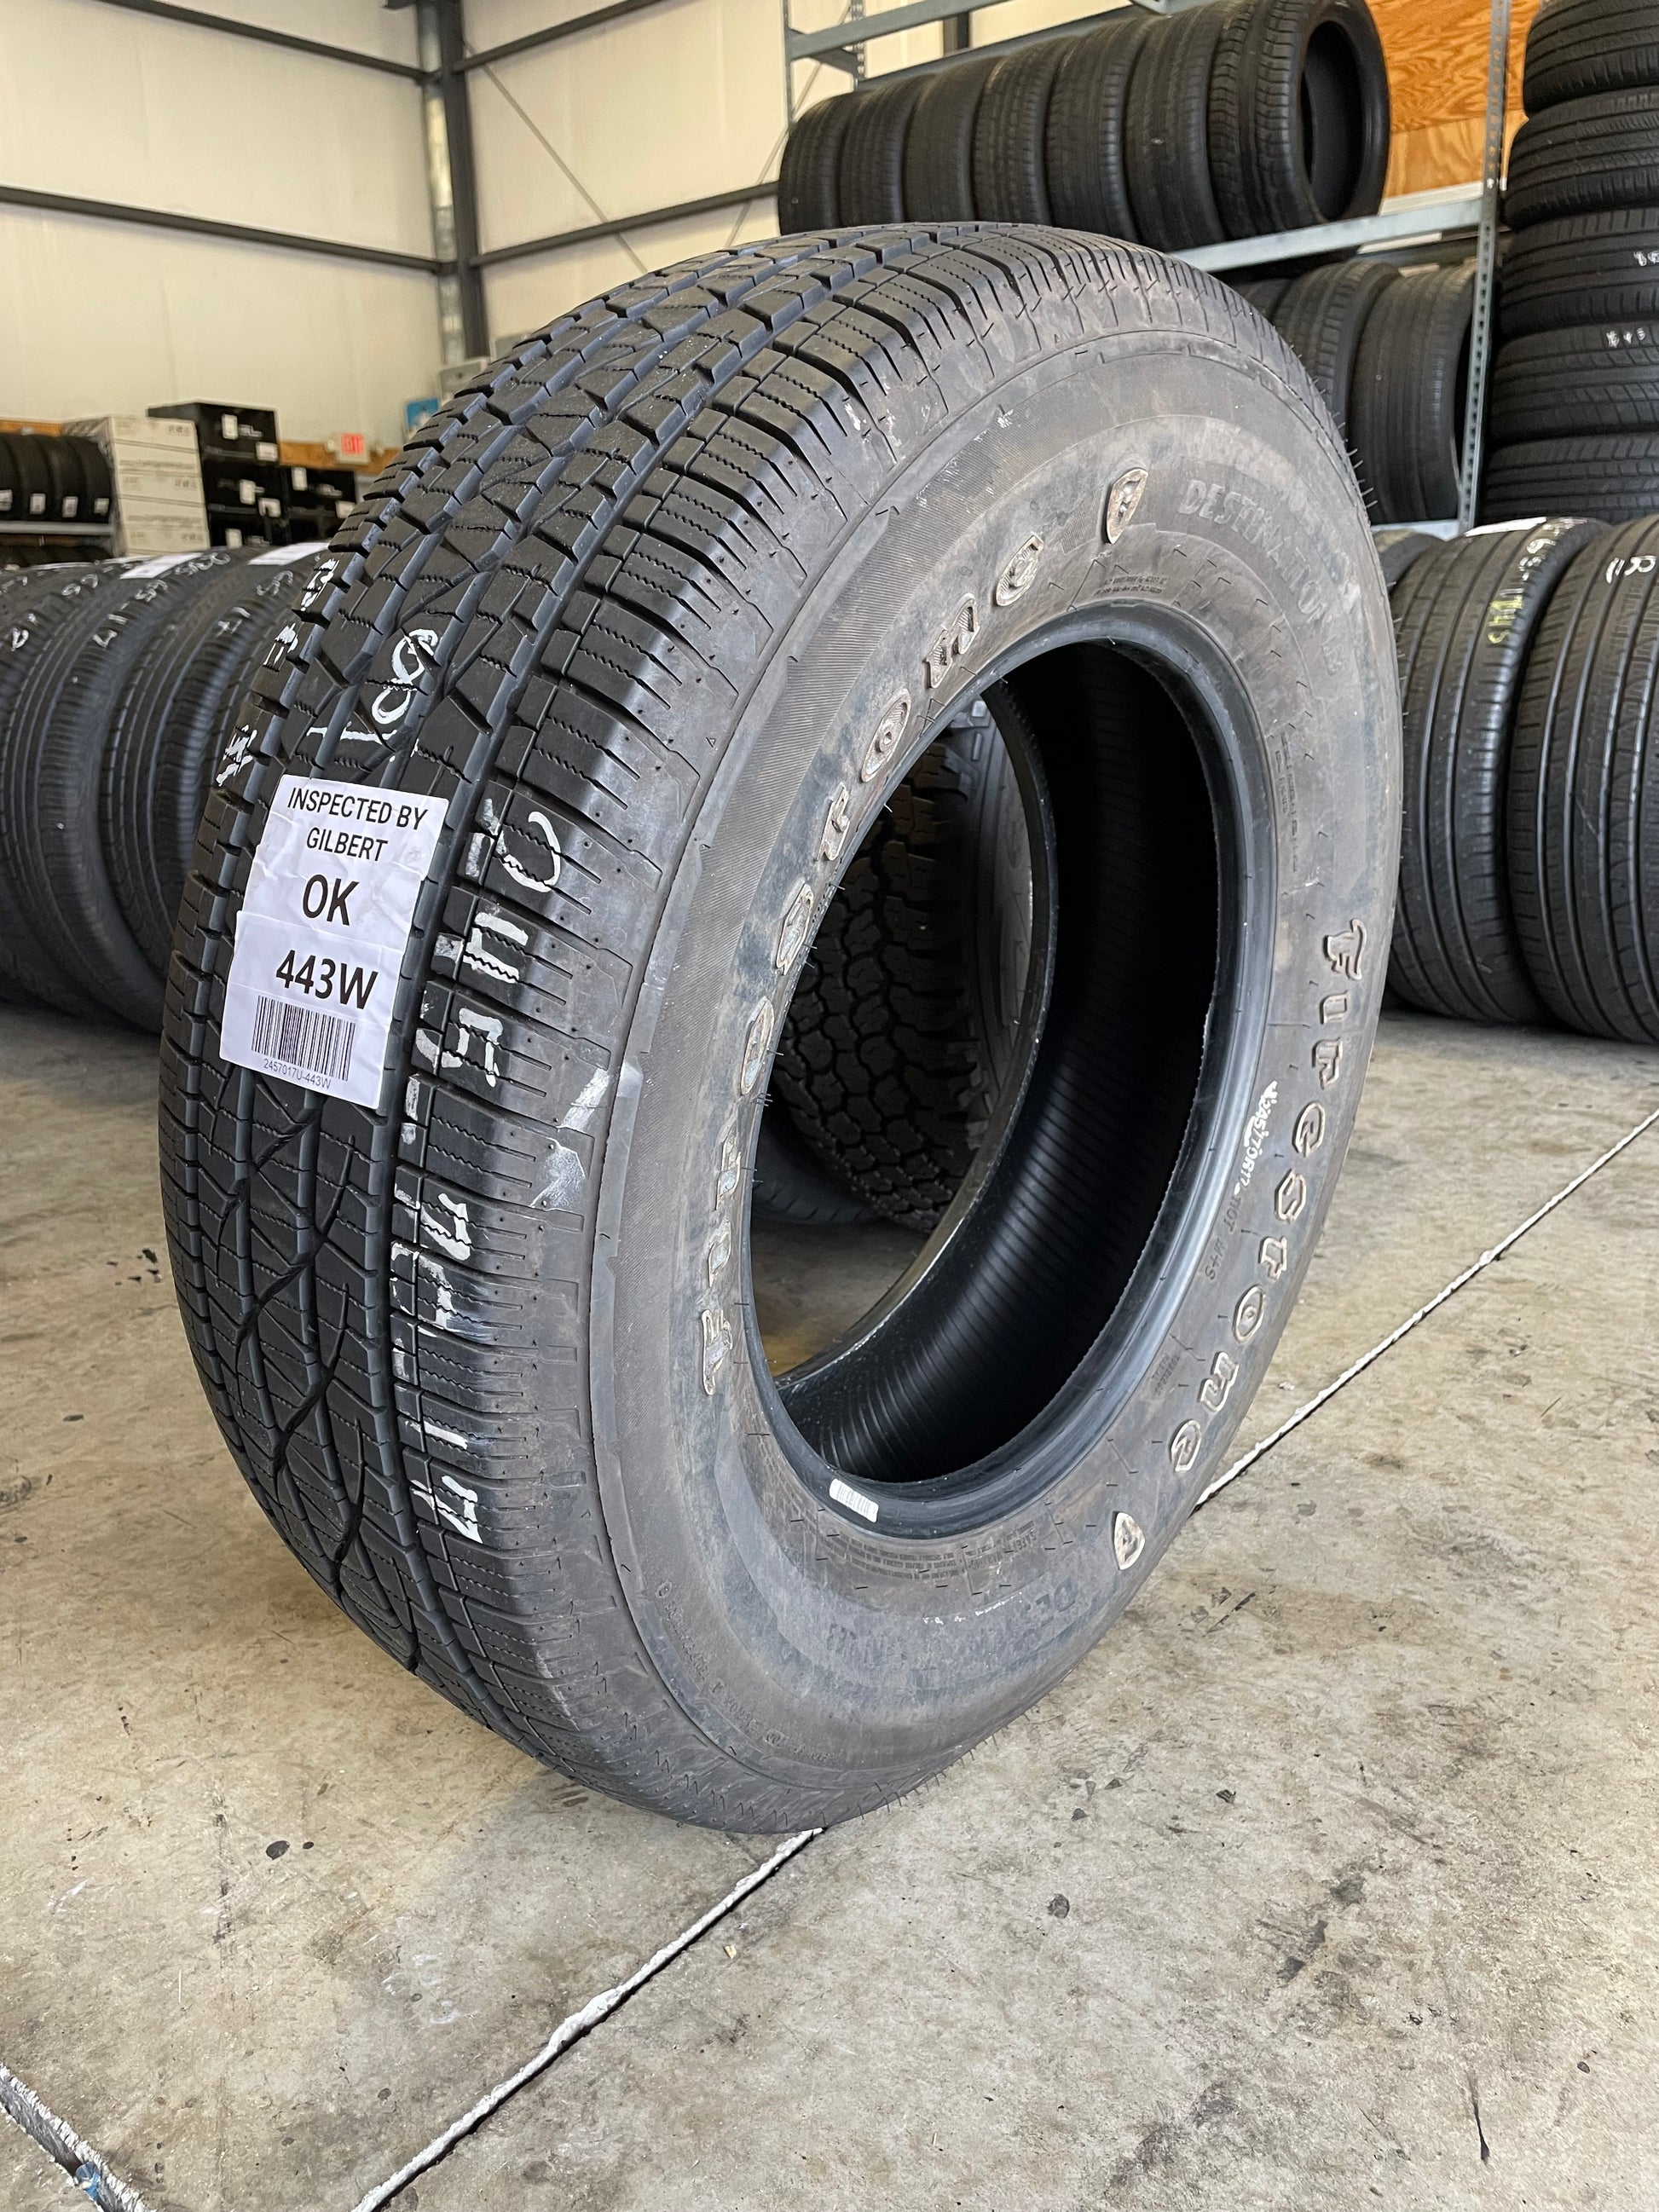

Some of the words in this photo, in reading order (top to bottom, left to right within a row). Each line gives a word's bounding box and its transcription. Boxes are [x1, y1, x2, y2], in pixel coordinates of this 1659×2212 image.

[286, 787, 393, 824] INSPECTED
[396, 804, 428, 830] BY
[306, 827, 389, 863] GILBERT
[302, 874, 360, 927] OK
[275, 950, 379, 1010] 443W
[263, 1058, 332, 1090] 2457017U-443W
[1171, 918, 1367, 1472] Firestone
